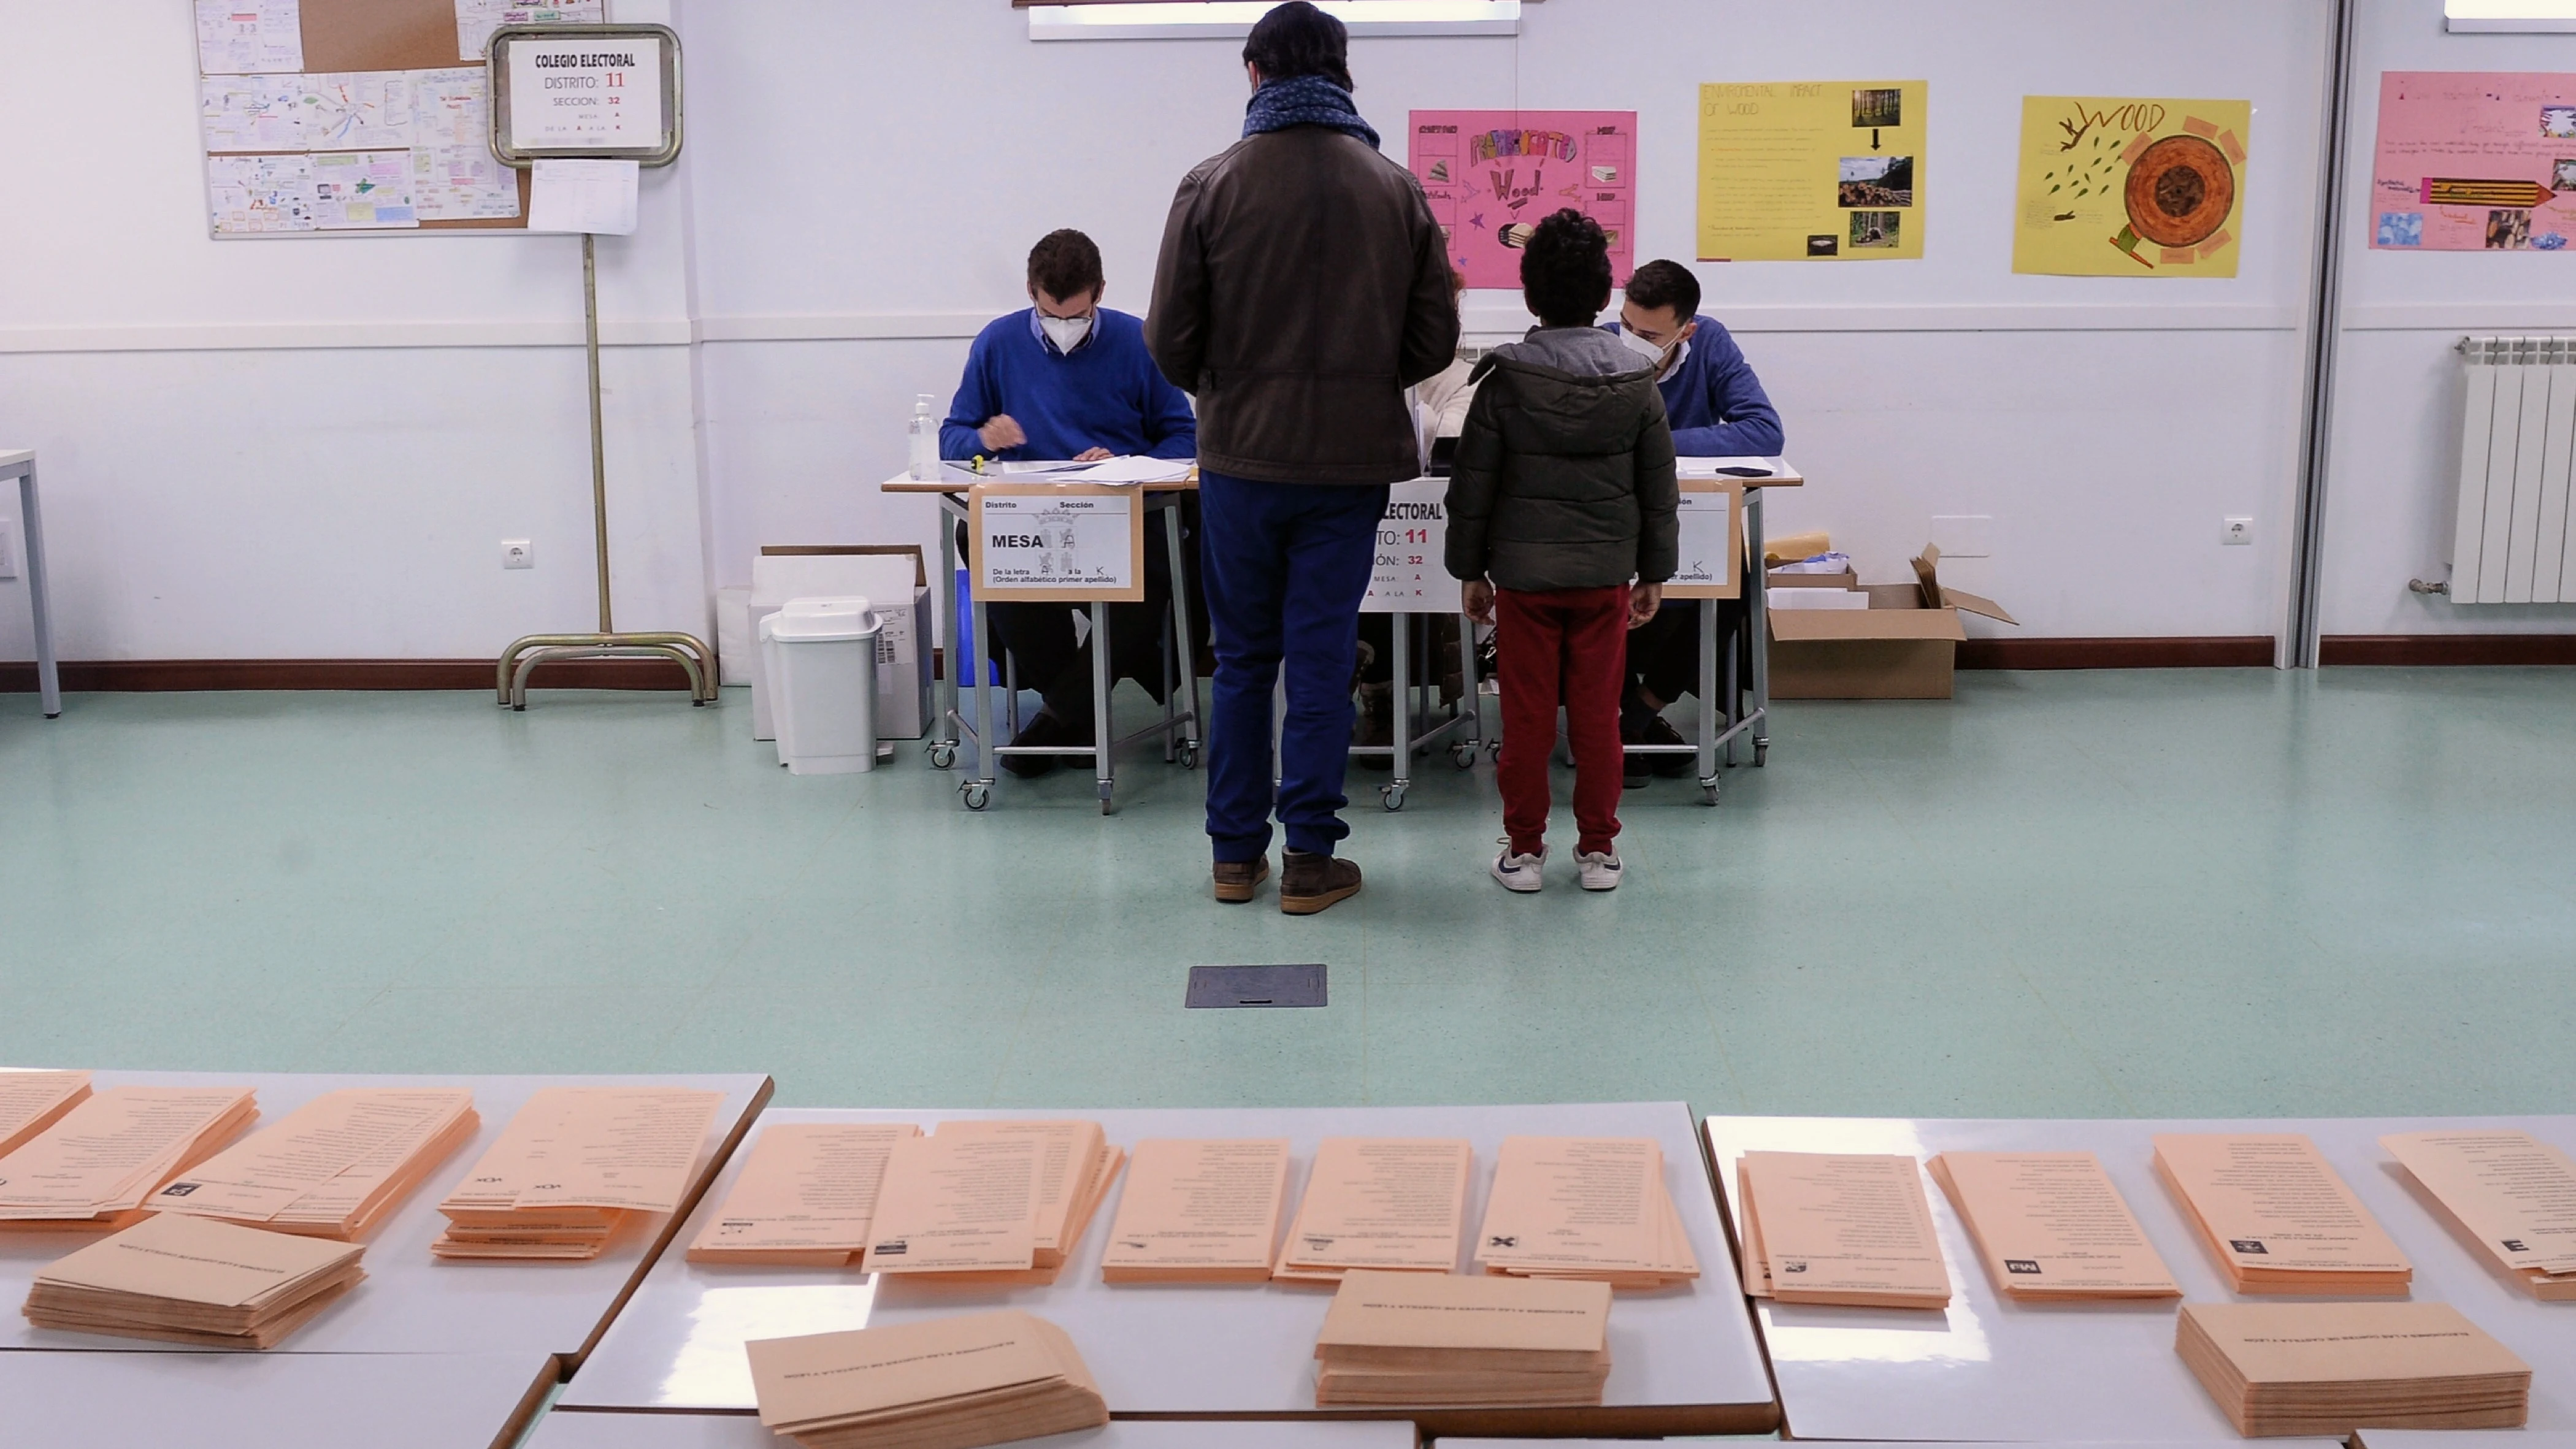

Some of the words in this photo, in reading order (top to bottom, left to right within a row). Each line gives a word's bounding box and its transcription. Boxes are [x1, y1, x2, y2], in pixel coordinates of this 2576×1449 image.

[535, 54, 577, 68] COLEGIO
[581, 53, 635, 67] ELECTORAL
[545, 77, 599, 89] DISTRITO:
[605, 72, 625, 88] 11
[1728, 102, 1759, 115] WOOD
[2075, 102, 2165, 132] WOOD
[1490, 169, 1541, 201] Wood
[992, 535, 1044, 548] MESA
[1405, 529, 1427, 544] 11
[1408, 556, 1423, 565] 32
[1693, 560, 1704, 573] K
[1096, 566, 1104, 575] K
